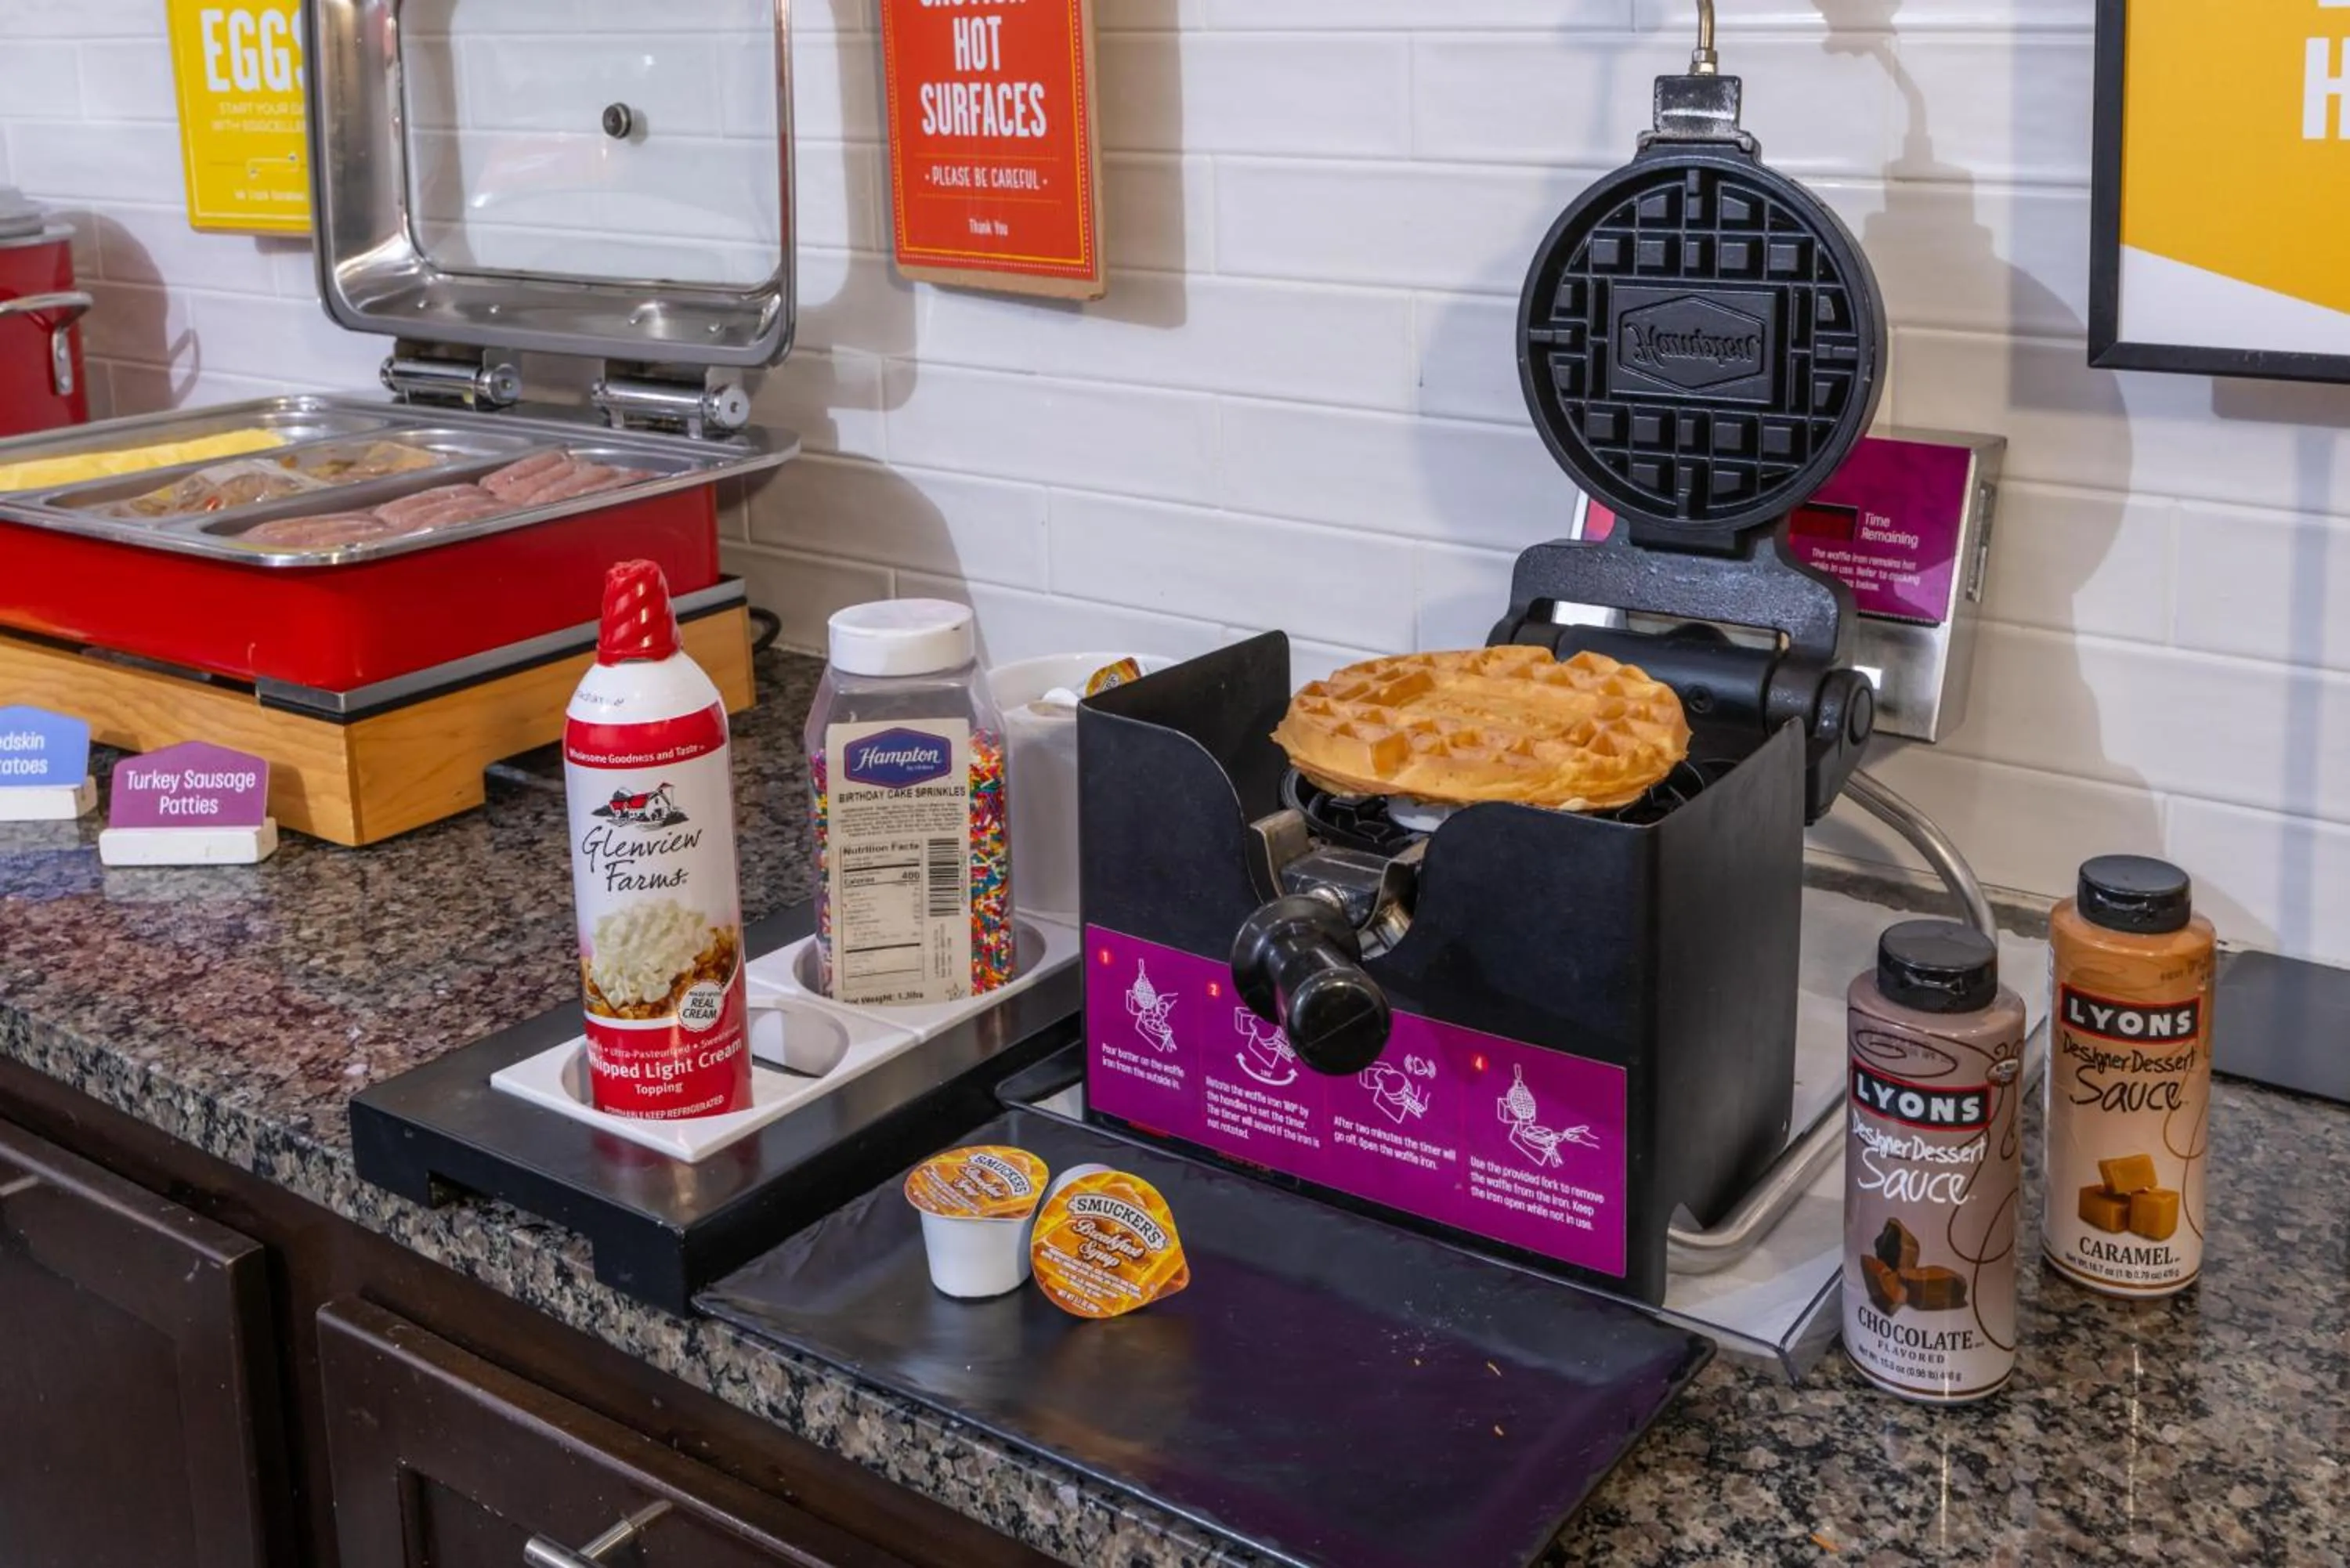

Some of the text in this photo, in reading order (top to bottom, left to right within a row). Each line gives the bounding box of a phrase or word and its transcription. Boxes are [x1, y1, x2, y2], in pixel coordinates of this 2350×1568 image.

[953, 16, 1002, 71] HOT
[920, 82, 1047, 138] SURFACES
[932, 166, 1041, 190] PLEASE BE CAREFUL
[969, 219, 1009, 237] Thank You
[1864, 511, 1891, 527] Time
[1861, 526, 1919, 549] Remaining
[1812, 547, 1826, 558] The
[0, 732, 45, 751] dskin
[608, 753, 655, 764] Goodness
[656, 750, 674, 761] and
[675, 744, 698, 757] Taste
[852, 746, 941, 771] Hampton
[126, 769, 257, 794] Turkey Sausage
[838, 786, 966, 803] BIRTHDAY CAKE SPRINKLES
[159, 796, 219, 815] Patties
[582, 826, 703, 873] Glenview
[844, 840, 920, 855] Nutrition Facts
[604, 859, 689, 892] Farms
[1103, 951, 1109, 964] 1
[682, 1008, 718, 1019] CREAM
[691, 997, 715, 1008] REAL
[2070, 998, 2192, 1036] LYONS
[645, 1057, 694, 1081] Light
[698, 1038, 743, 1068] Cream
[2063, 1031, 2196, 1074] Designer Dessert
[634, 1082, 684, 1097] Topping
[1856, 1072, 1980, 1122] LYONS
[2070, 1064, 2182, 1114] Sauce
[667, 1093, 725, 1118] REFRIGERATED
[1333, 1115, 1354, 1130] After
[1355, 1122, 1370, 1136] two
[1404, 1136, 1419, 1150] the
[1852, 1107, 1987, 1165] Designer Dessert
[1470, 1155, 1486, 1170] Use
[1486, 1160, 1502, 1175] the
[1502, 1166, 1540, 1186] provided
[1541, 1175, 1559, 1190] fork
[1571, 1186, 1605, 1204] remove
[1857, 1147, 1969, 1205] Sauce
[1470, 1171, 1486, 1184] the
[1513, 1183, 1535, 1199] from
[1535, 1190, 1551, 1204] the
[1572, 1200, 1594, 1218] Keep
[1470, 1186, 1486, 1199] the
[1486, 1188, 1503, 1204] iron
[1503, 1197, 1526, 1212] open
[1076, 1198, 1162, 1246] SMUCKER'S
[1074, 1219, 1144, 1259] Breakfast
[2080, 1236, 2174, 1266] CARAMEL
[1079, 1241, 1120, 1268] Syrup
[1857, 1305, 1975, 1352] CHOCOLATE
[1878, 1340, 1946, 1364] FLAVORED
